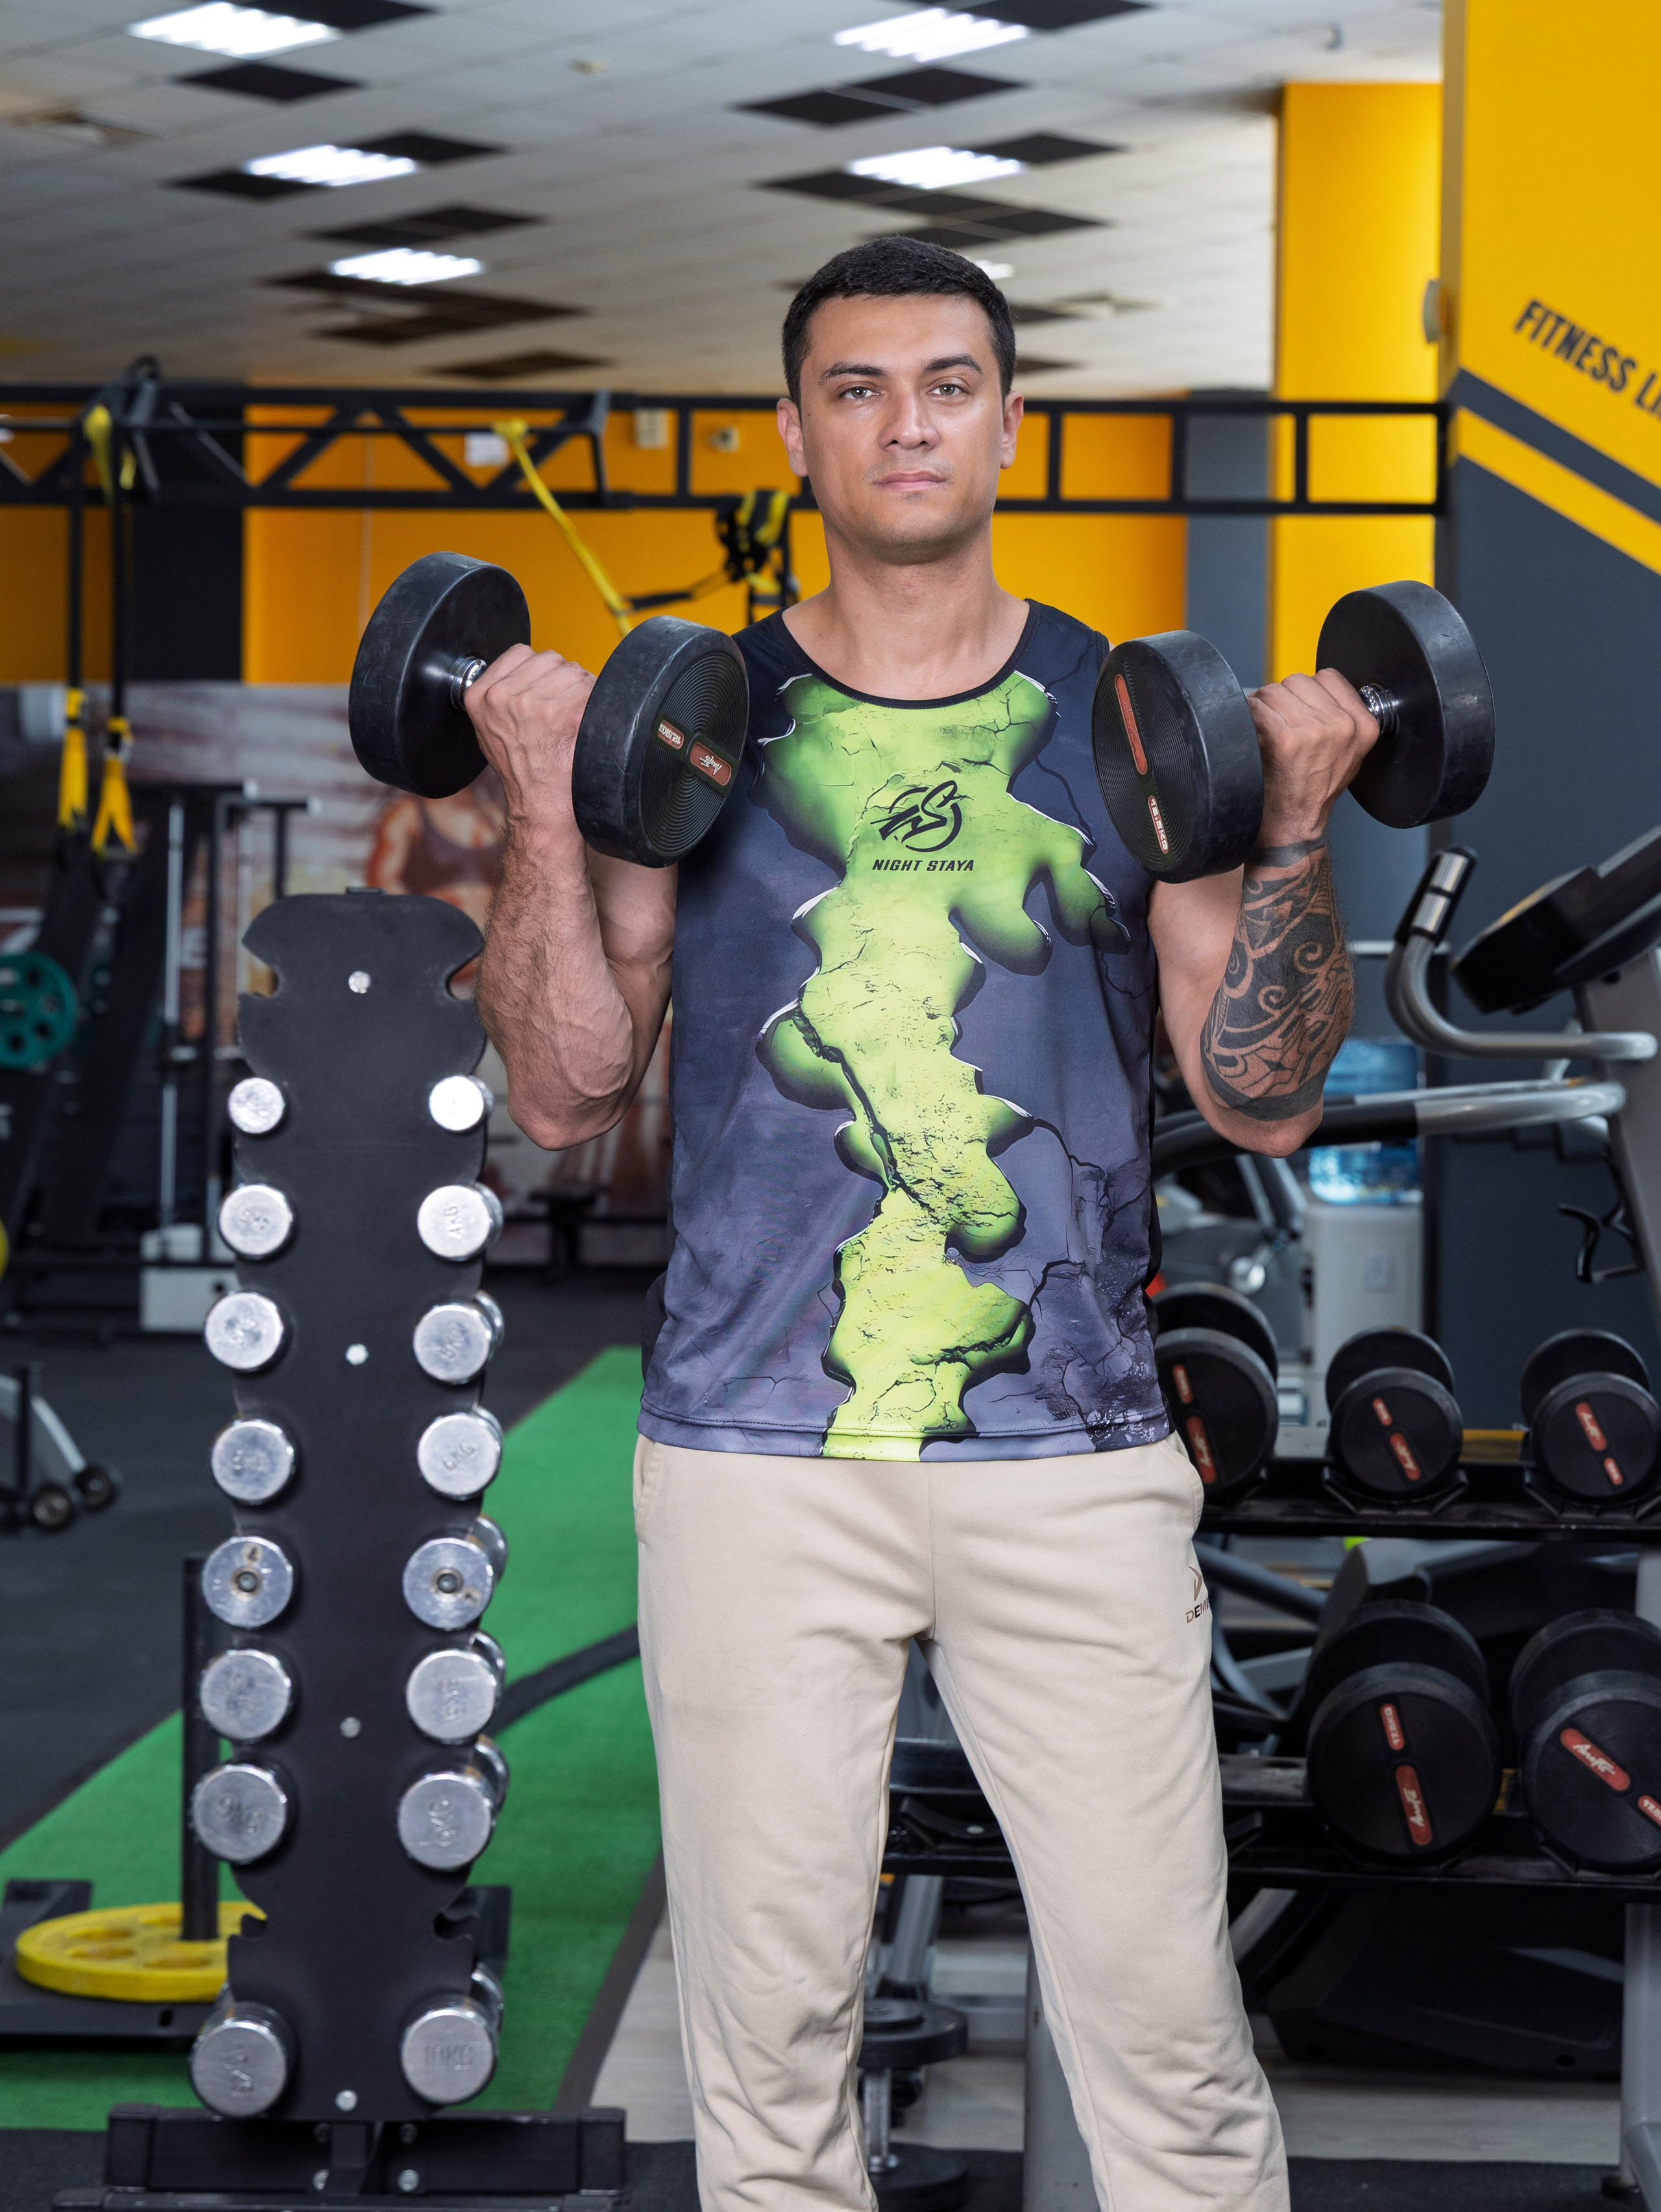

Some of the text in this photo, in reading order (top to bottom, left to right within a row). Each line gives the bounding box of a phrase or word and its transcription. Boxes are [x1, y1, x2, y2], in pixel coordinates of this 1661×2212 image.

[1513, 298, 1661, 422] FITNESS LI
[659, 723, 682, 745] 12.5KG
[872, 860, 974, 871] NIGHT STAYA
